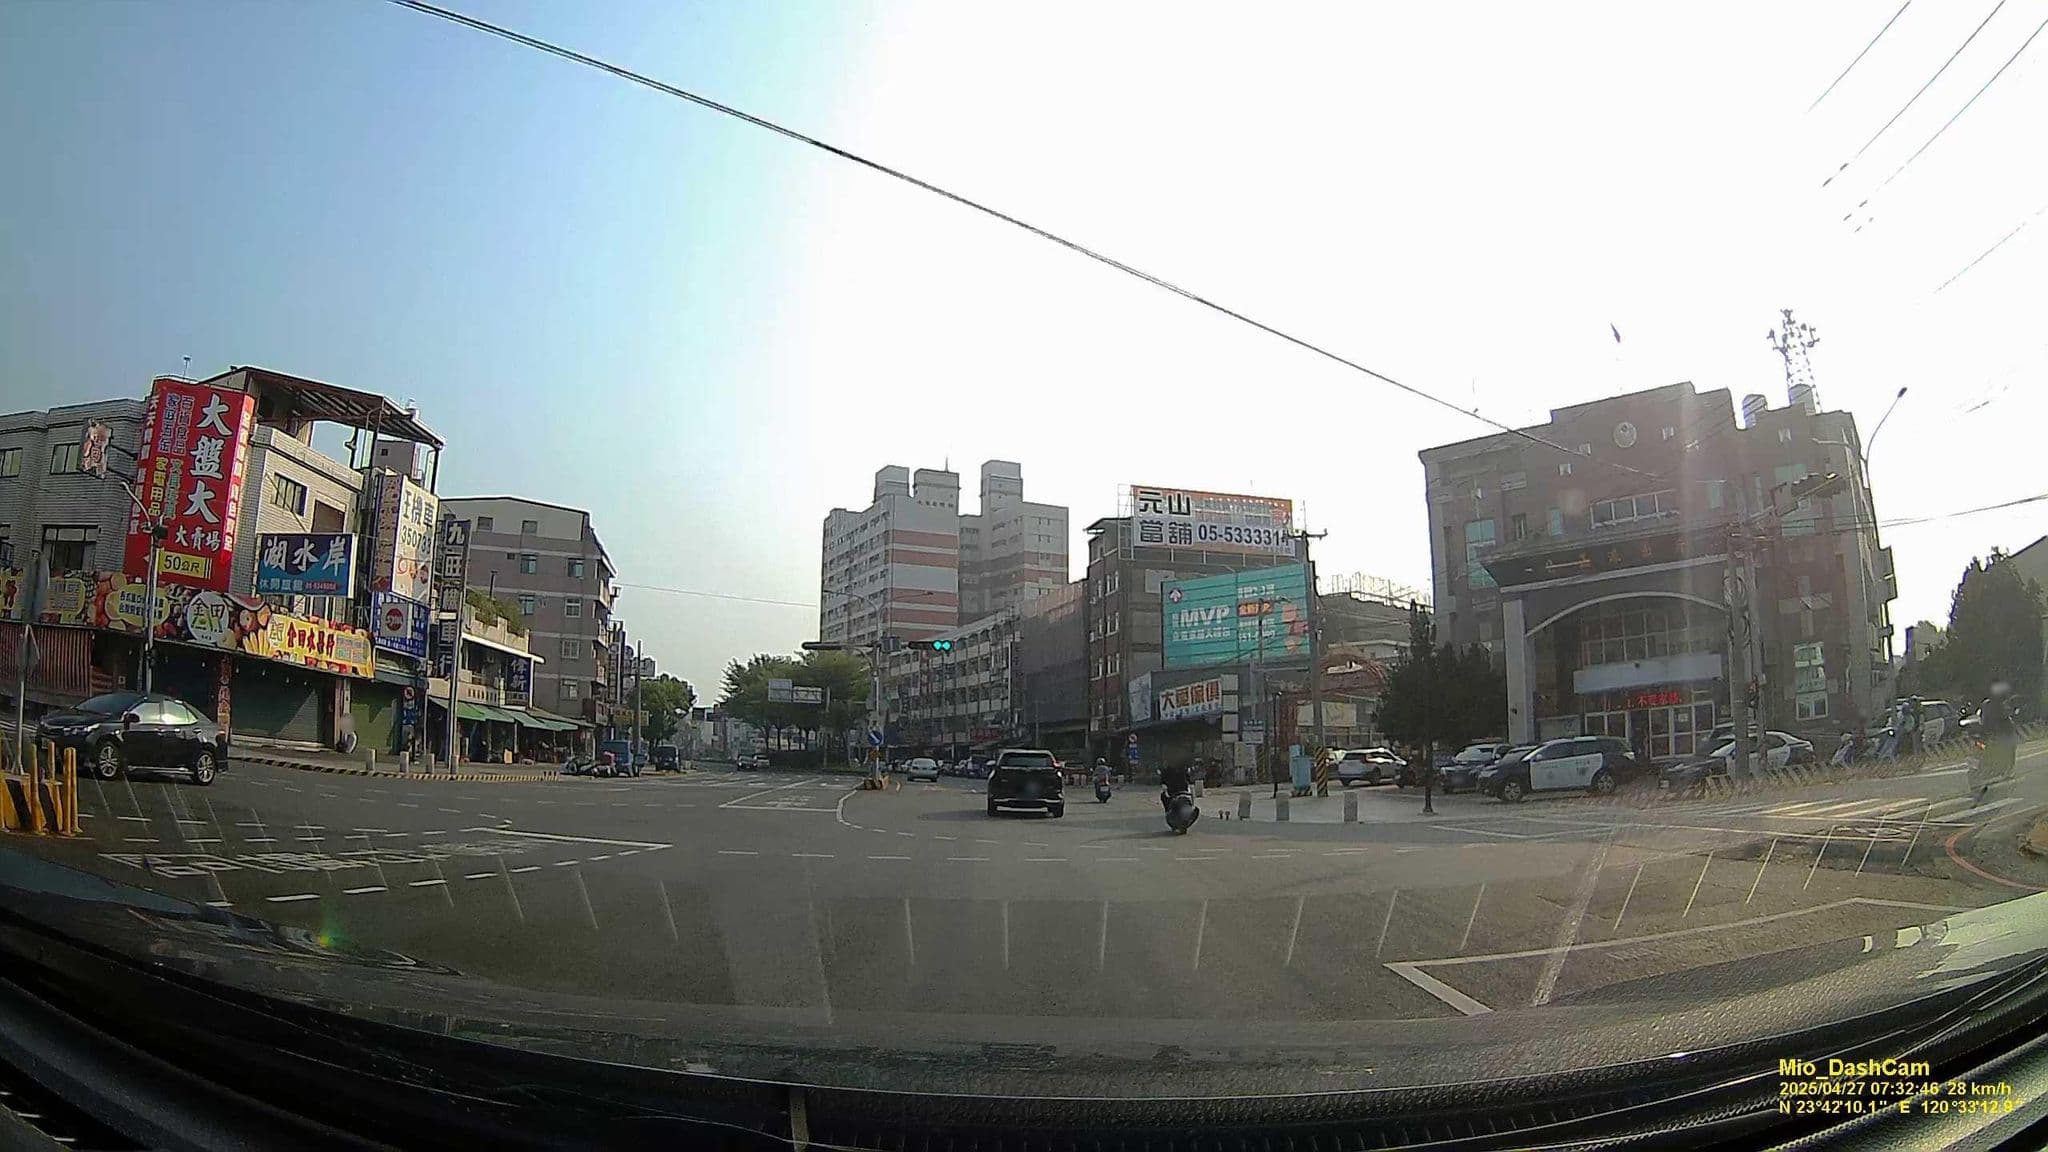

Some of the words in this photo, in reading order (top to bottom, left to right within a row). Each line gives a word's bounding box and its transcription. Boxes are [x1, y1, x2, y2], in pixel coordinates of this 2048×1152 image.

[183, 392, 233, 524] 大盤大
[1139, 488, 1192, 516] 元山
[1139, 519, 1194, 546] 當舖
[163, 554, 200, 574] 50公尺
[264, 536, 347, 577] 湖水岸
